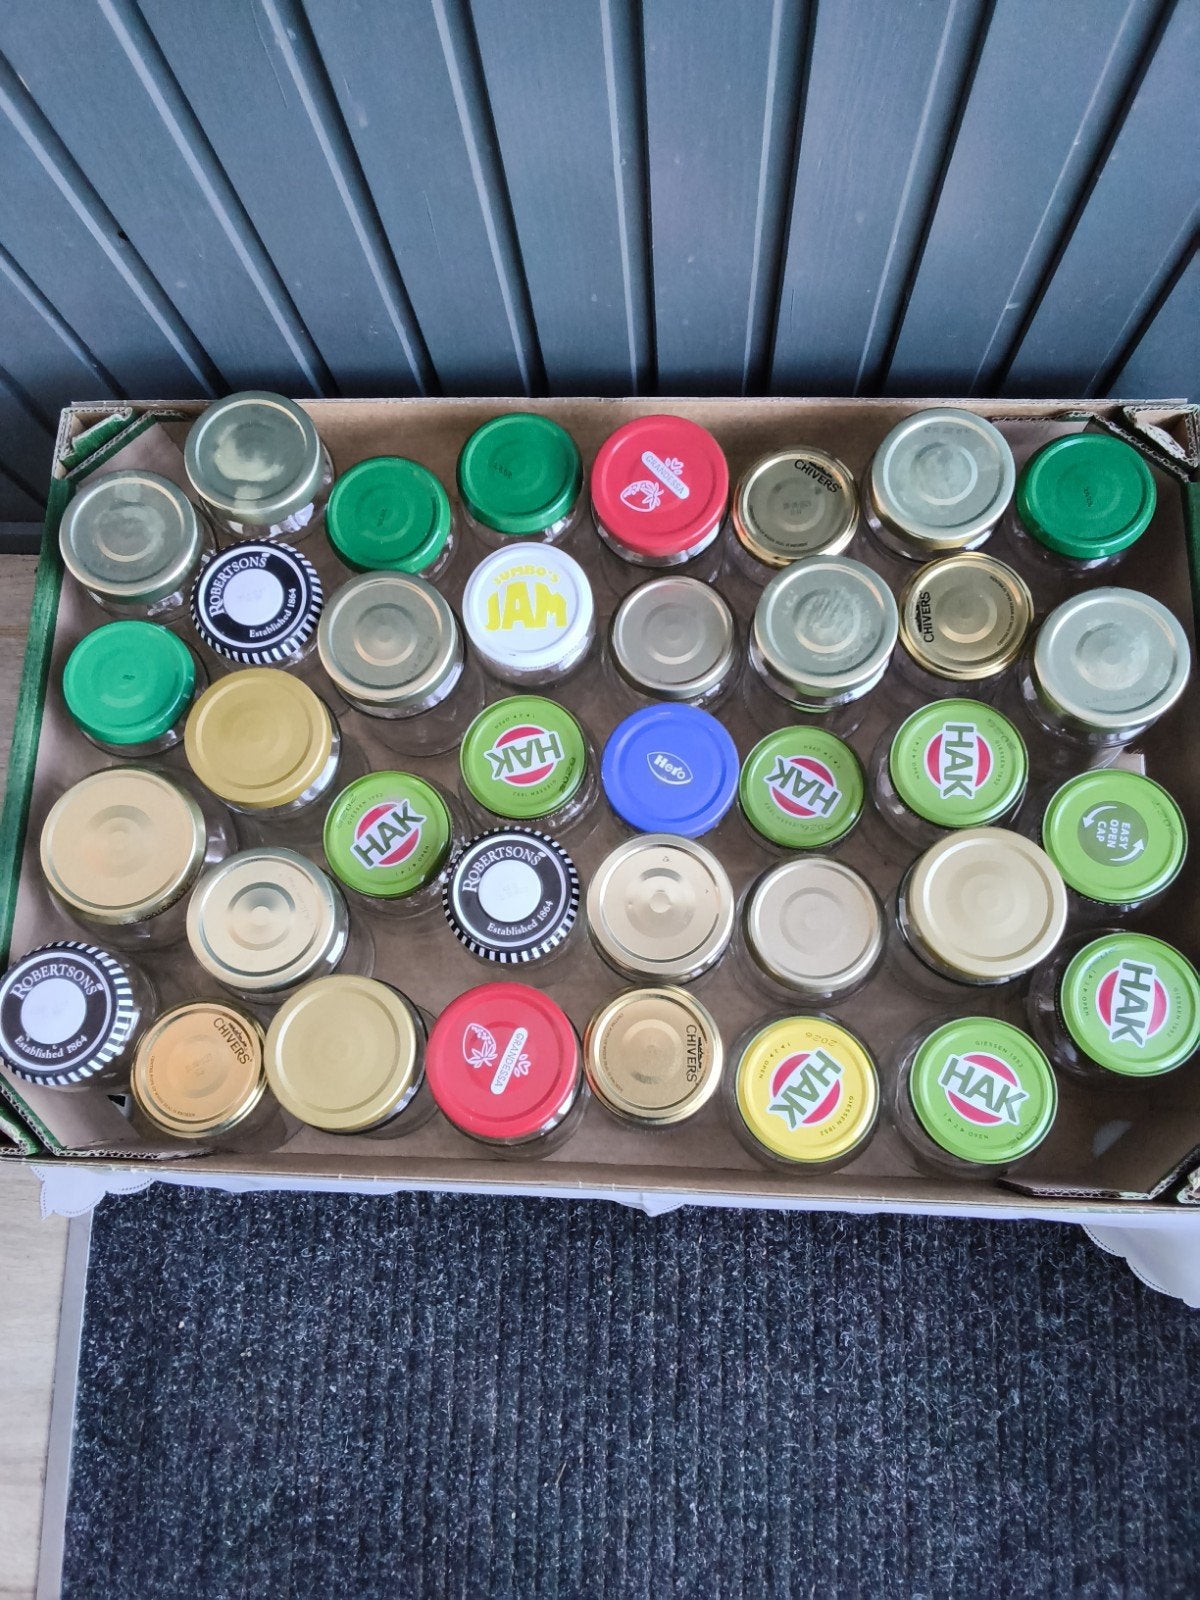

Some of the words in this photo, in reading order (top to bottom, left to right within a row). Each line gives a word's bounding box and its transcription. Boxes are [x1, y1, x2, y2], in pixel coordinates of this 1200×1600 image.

[645, 455, 686, 494] GRANDESSA
[794, 459, 840, 493] CHIVERS
[209, 556, 268, 618] ROBERTSONS
[484, 581, 568, 631] JAM
[249, 609, 292, 638] Established
[287, 588, 297, 608] 1864
[920, 591, 935, 643] CHIVERS
[486, 733, 562, 778] HAK
[654, 754, 686, 780] Hero
[943, 725, 975, 797] HAK
[766, 757, 839, 815] HAK
[353, 800, 425, 867] HAK
[1096, 820, 1107, 842] CAP
[1107, 819, 1119, 848] OPEN
[1119, 822, 1131, 850] EASY
[462, 846, 541, 893] ROBERTSONS
[486, 918, 538, 936] Established
[537, 900, 554, 921] 1864
[9, 963, 98, 1000] ROBERTSONS
[1111, 962, 1153, 1045] HAK
[14, 1035, 64, 1059] Established
[66, 1035, 88, 1054] 1864
[213, 1017, 250, 1065] CHIVERS
[495, 1032, 525, 1087] GRANDESSA
[685, 1024, 698, 1083] CHIVERS
[769, 1050, 842, 1129] HAK
[941, 1057, 1027, 1123] HAK
